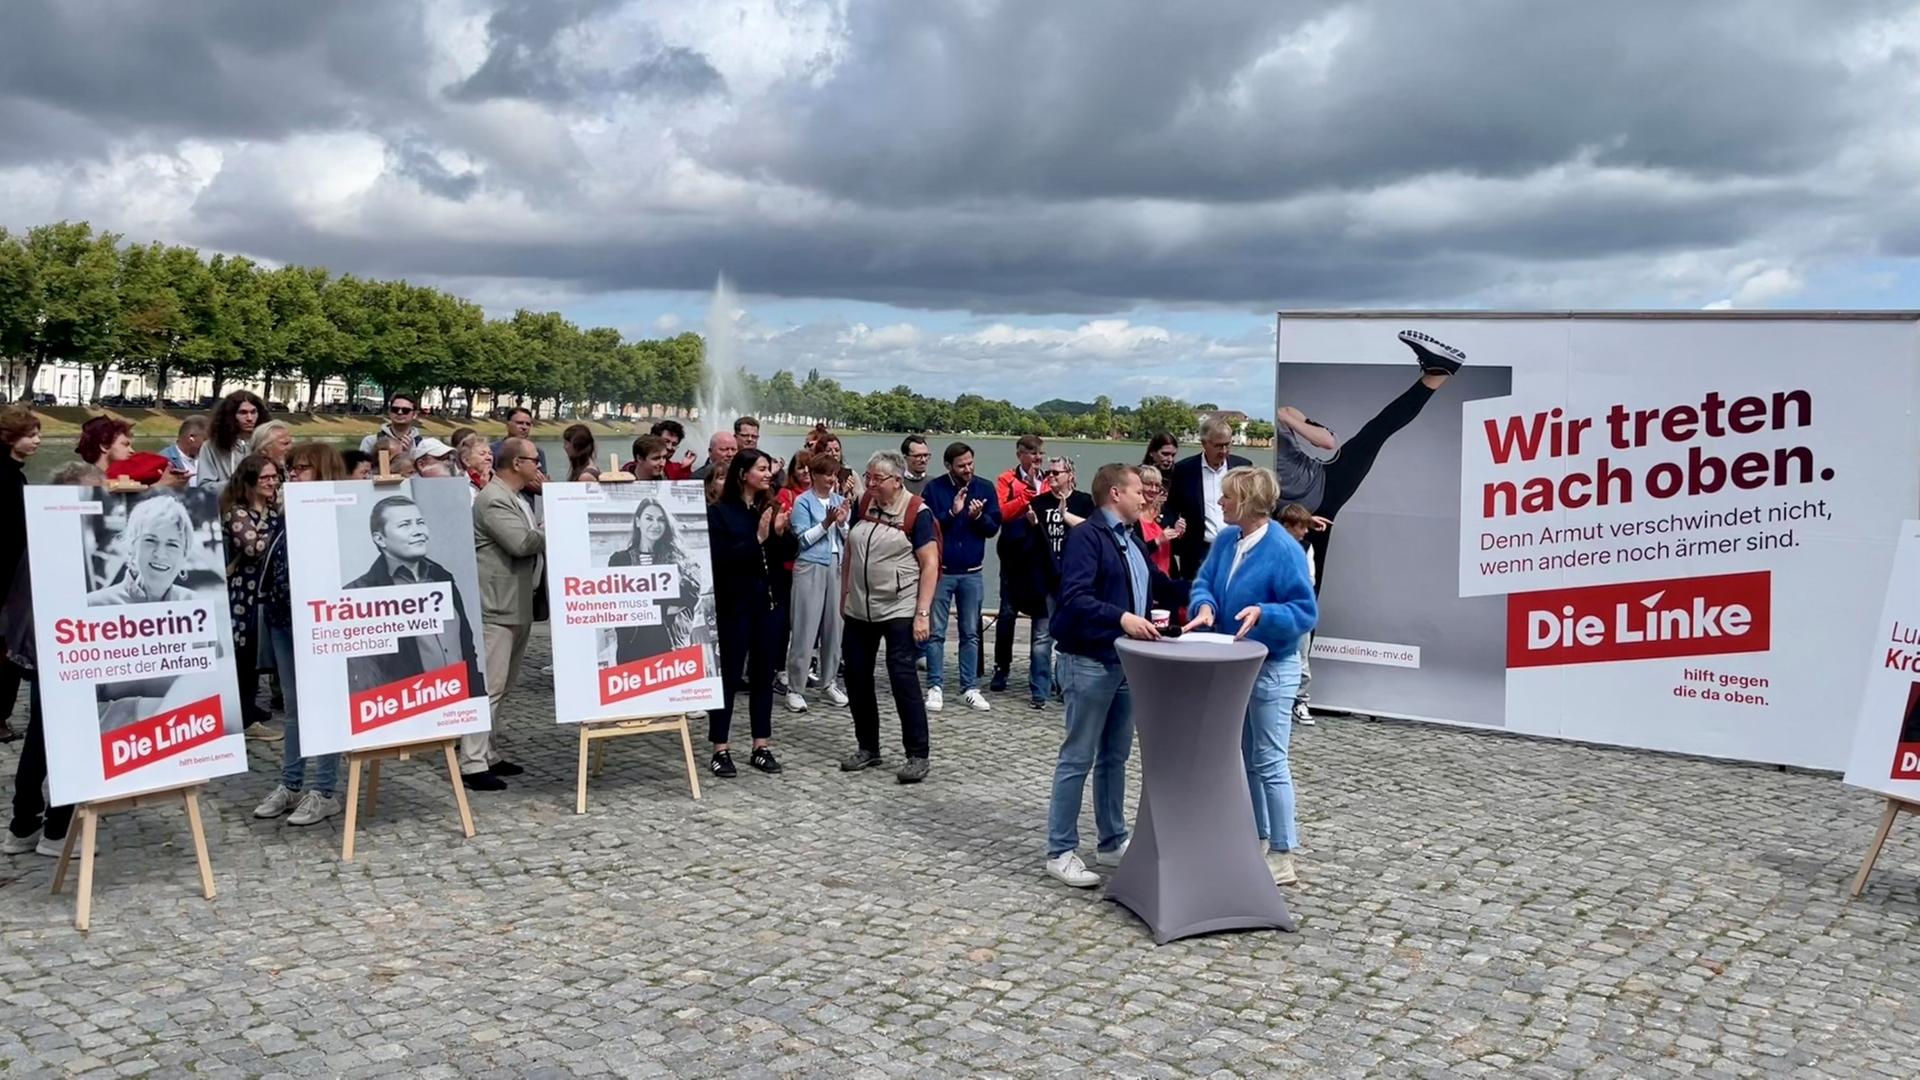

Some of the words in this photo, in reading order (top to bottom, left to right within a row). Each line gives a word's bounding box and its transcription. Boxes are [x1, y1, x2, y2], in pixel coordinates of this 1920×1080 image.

[1483, 406, 1592, 464] Wir
[1606, 389, 1812, 449] treten
[1483, 458, 1632, 518] nach
[1646, 445, 1835, 499] oben.
[1481, 533, 1533, 551] Denn
[1540, 522, 1603, 546] Armut
[1610, 507, 1760, 537] verschwindet
[1769, 500, 1832, 524] nicht,
[1480, 557, 1533, 575] wenn
[1538, 550, 1611, 571] andere
[1617, 540, 1670, 562] noch
[1676, 536, 1741, 558] ärmer
[1746, 529, 1799, 551] sind.
[564, 573, 672, 596] Radikal?
[307, 591, 443, 622] Träumer?
[566, 600, 617, 612] Wohnen
[618, 598, 648, 609] muss
[566, 613, 629, 625] bezahlbar
[631, 610, 657, 621] sein.
[55, 609, 208, 644] Streberin?
[311, 627, 340, 640] Eine
[343, 620, 404, 640] gerechte
[407, 618, 437, 631] Welt
[1528, 605, 1605, 650] Die
[1616, 590, 1751, 643] Linke
[57, 648, 100, 664] 1.000
[104, 646, 139, 660] neue
[142, 641, 186, 656] Lehrer
[312, 642, 328, 654] ist
[331, 637, 392, 652] machbar.
[1313, 644, 1413, 661] www.dielinke-mv.de
[59, 666, 102, 681] waren
[106, 662, 131, 677] erst
[135, 659, 156, 674] der
[160, 654, 211, 672] Anfang.
[607, 671, 642, 696] Die
[645, 658, 697, 687] Linke
[1684, 668, 1714, 683] hilft
[1719, 674, 1769, 690] gegen
[360, 695, 398, 723] Die
[401, 677, 461, 710] Linke
[1674, 685, 1696, 699] die
[1701, 688, 1720, 701] da
[1725, 690, 1769, 706] oben.
[112, 734, 152, 766] Die
[155, 714, 216, 750] Linke
